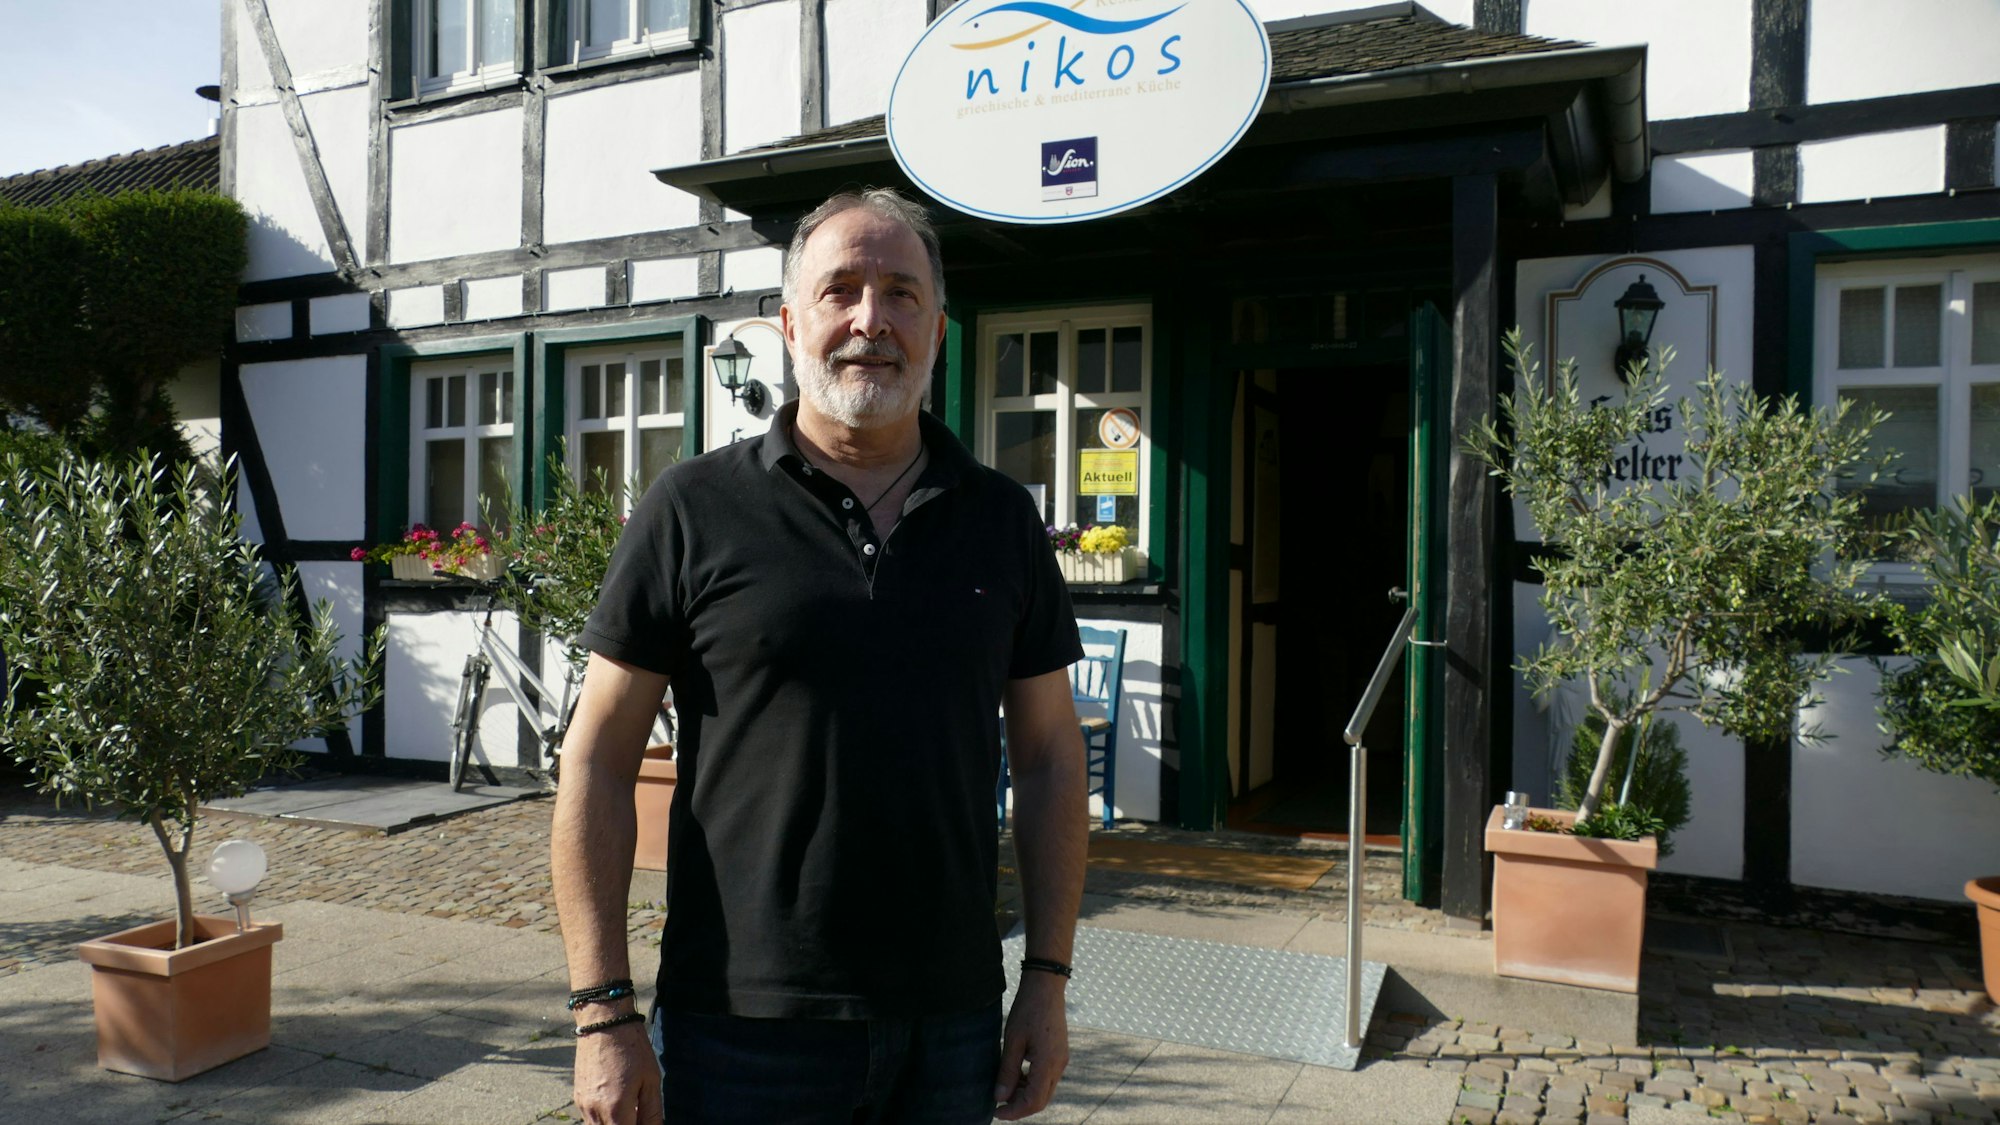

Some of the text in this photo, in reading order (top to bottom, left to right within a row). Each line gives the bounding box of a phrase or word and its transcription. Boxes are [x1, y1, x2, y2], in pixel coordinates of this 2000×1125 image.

[967, 35, 1181, 98] nikos
[957, 79, 1182, 118] griechische & mediterrane Küche
[1083, 472, 1132, 482] Aktuell
[1605, 444, 1683, 482] elter
